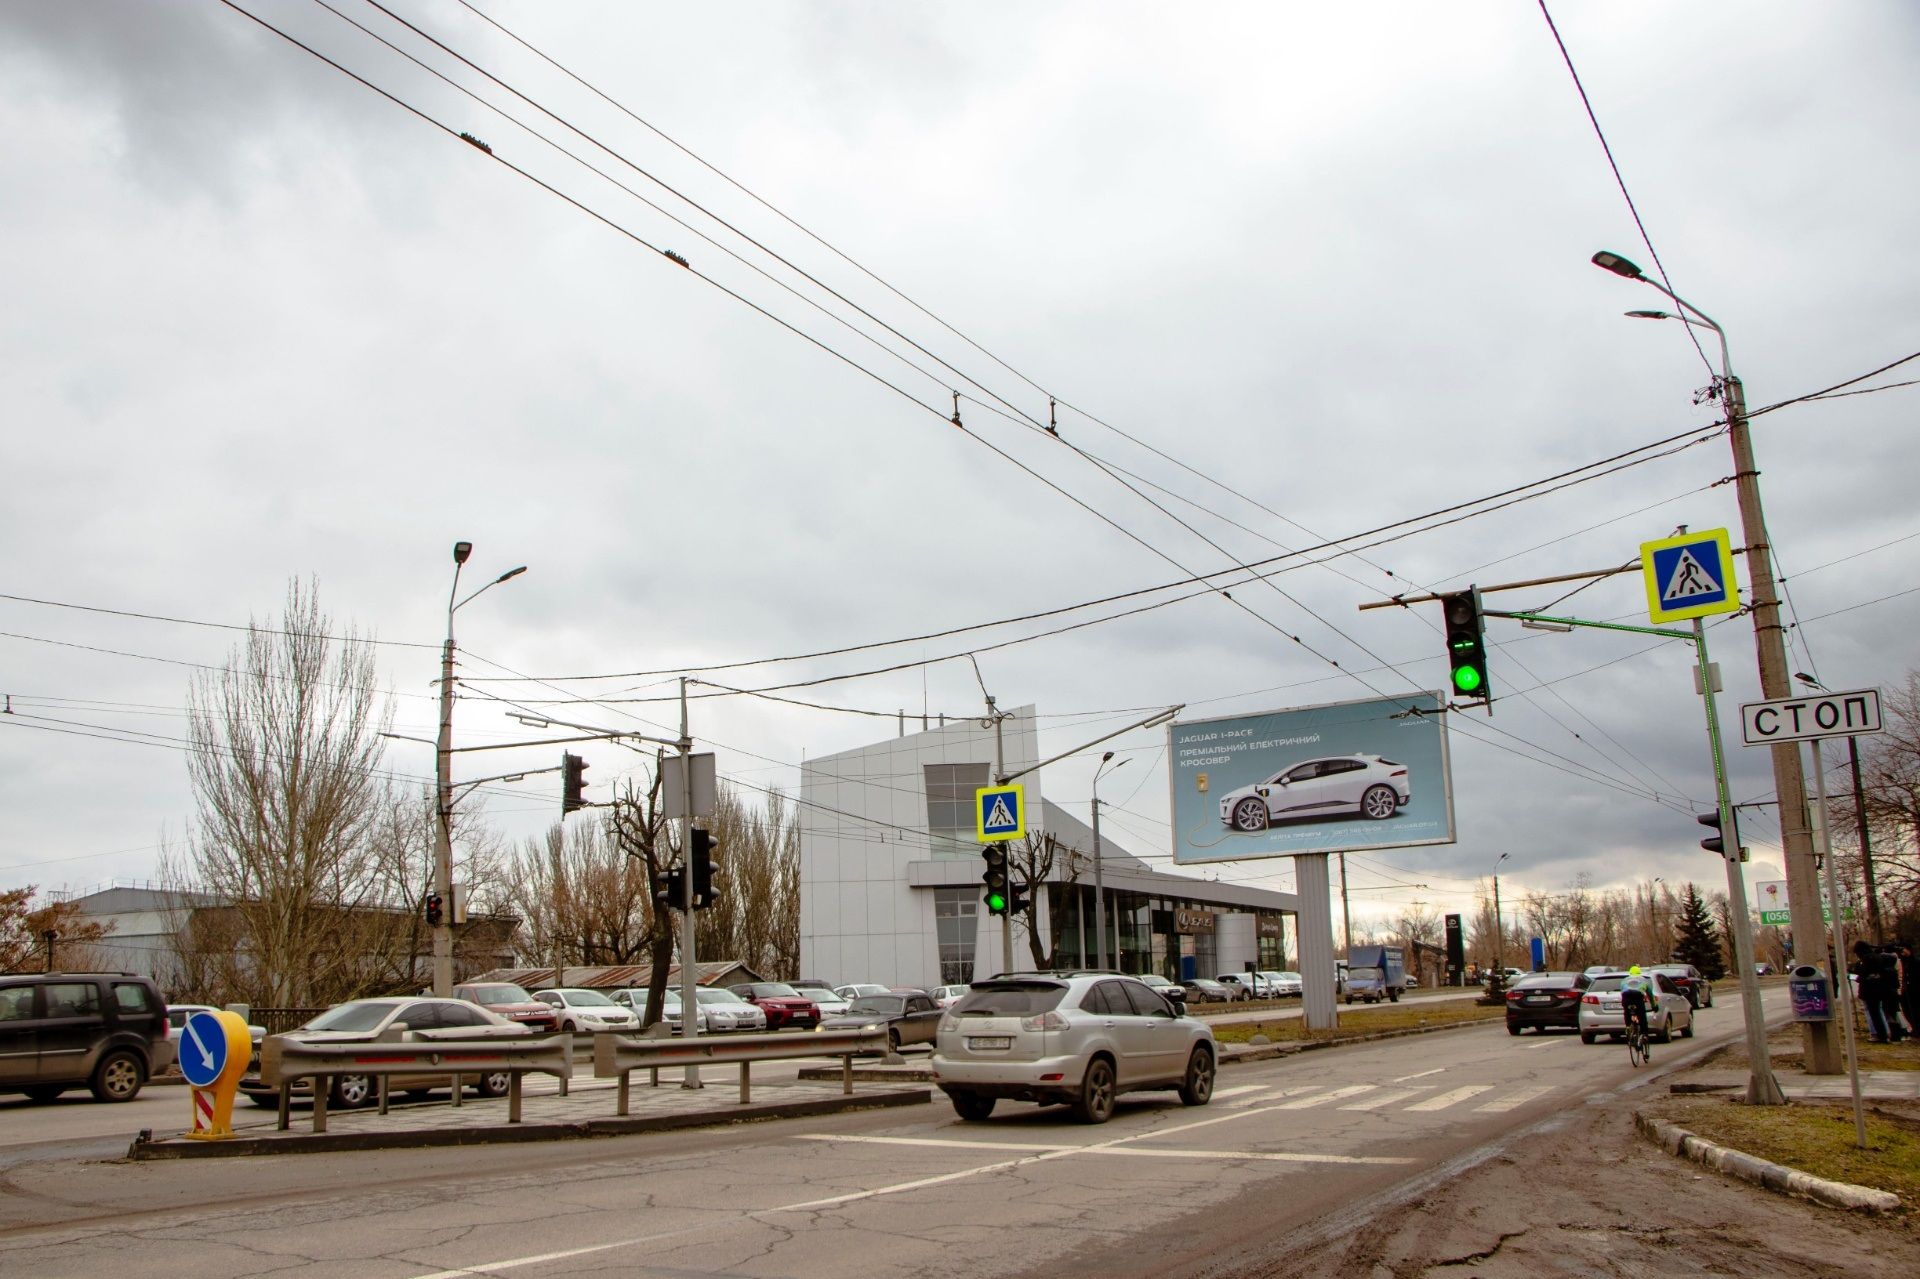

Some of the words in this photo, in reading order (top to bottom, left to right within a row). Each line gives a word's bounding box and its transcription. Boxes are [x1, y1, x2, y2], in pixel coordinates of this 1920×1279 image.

[1754, 696, 1868, 736] СТОП
[1179, 733, 1218, 744] JAGUAR
[1221, 728, 1254, 739] I-PACE
[1180, 741, 1247, 757] ПРЕМІАЛЬНИЙ
[1250, 733, 1320, 750] ЕЛЕКТРИЧНИЙ
[1180, 755, 1231, 767] КРОСОВЕР
